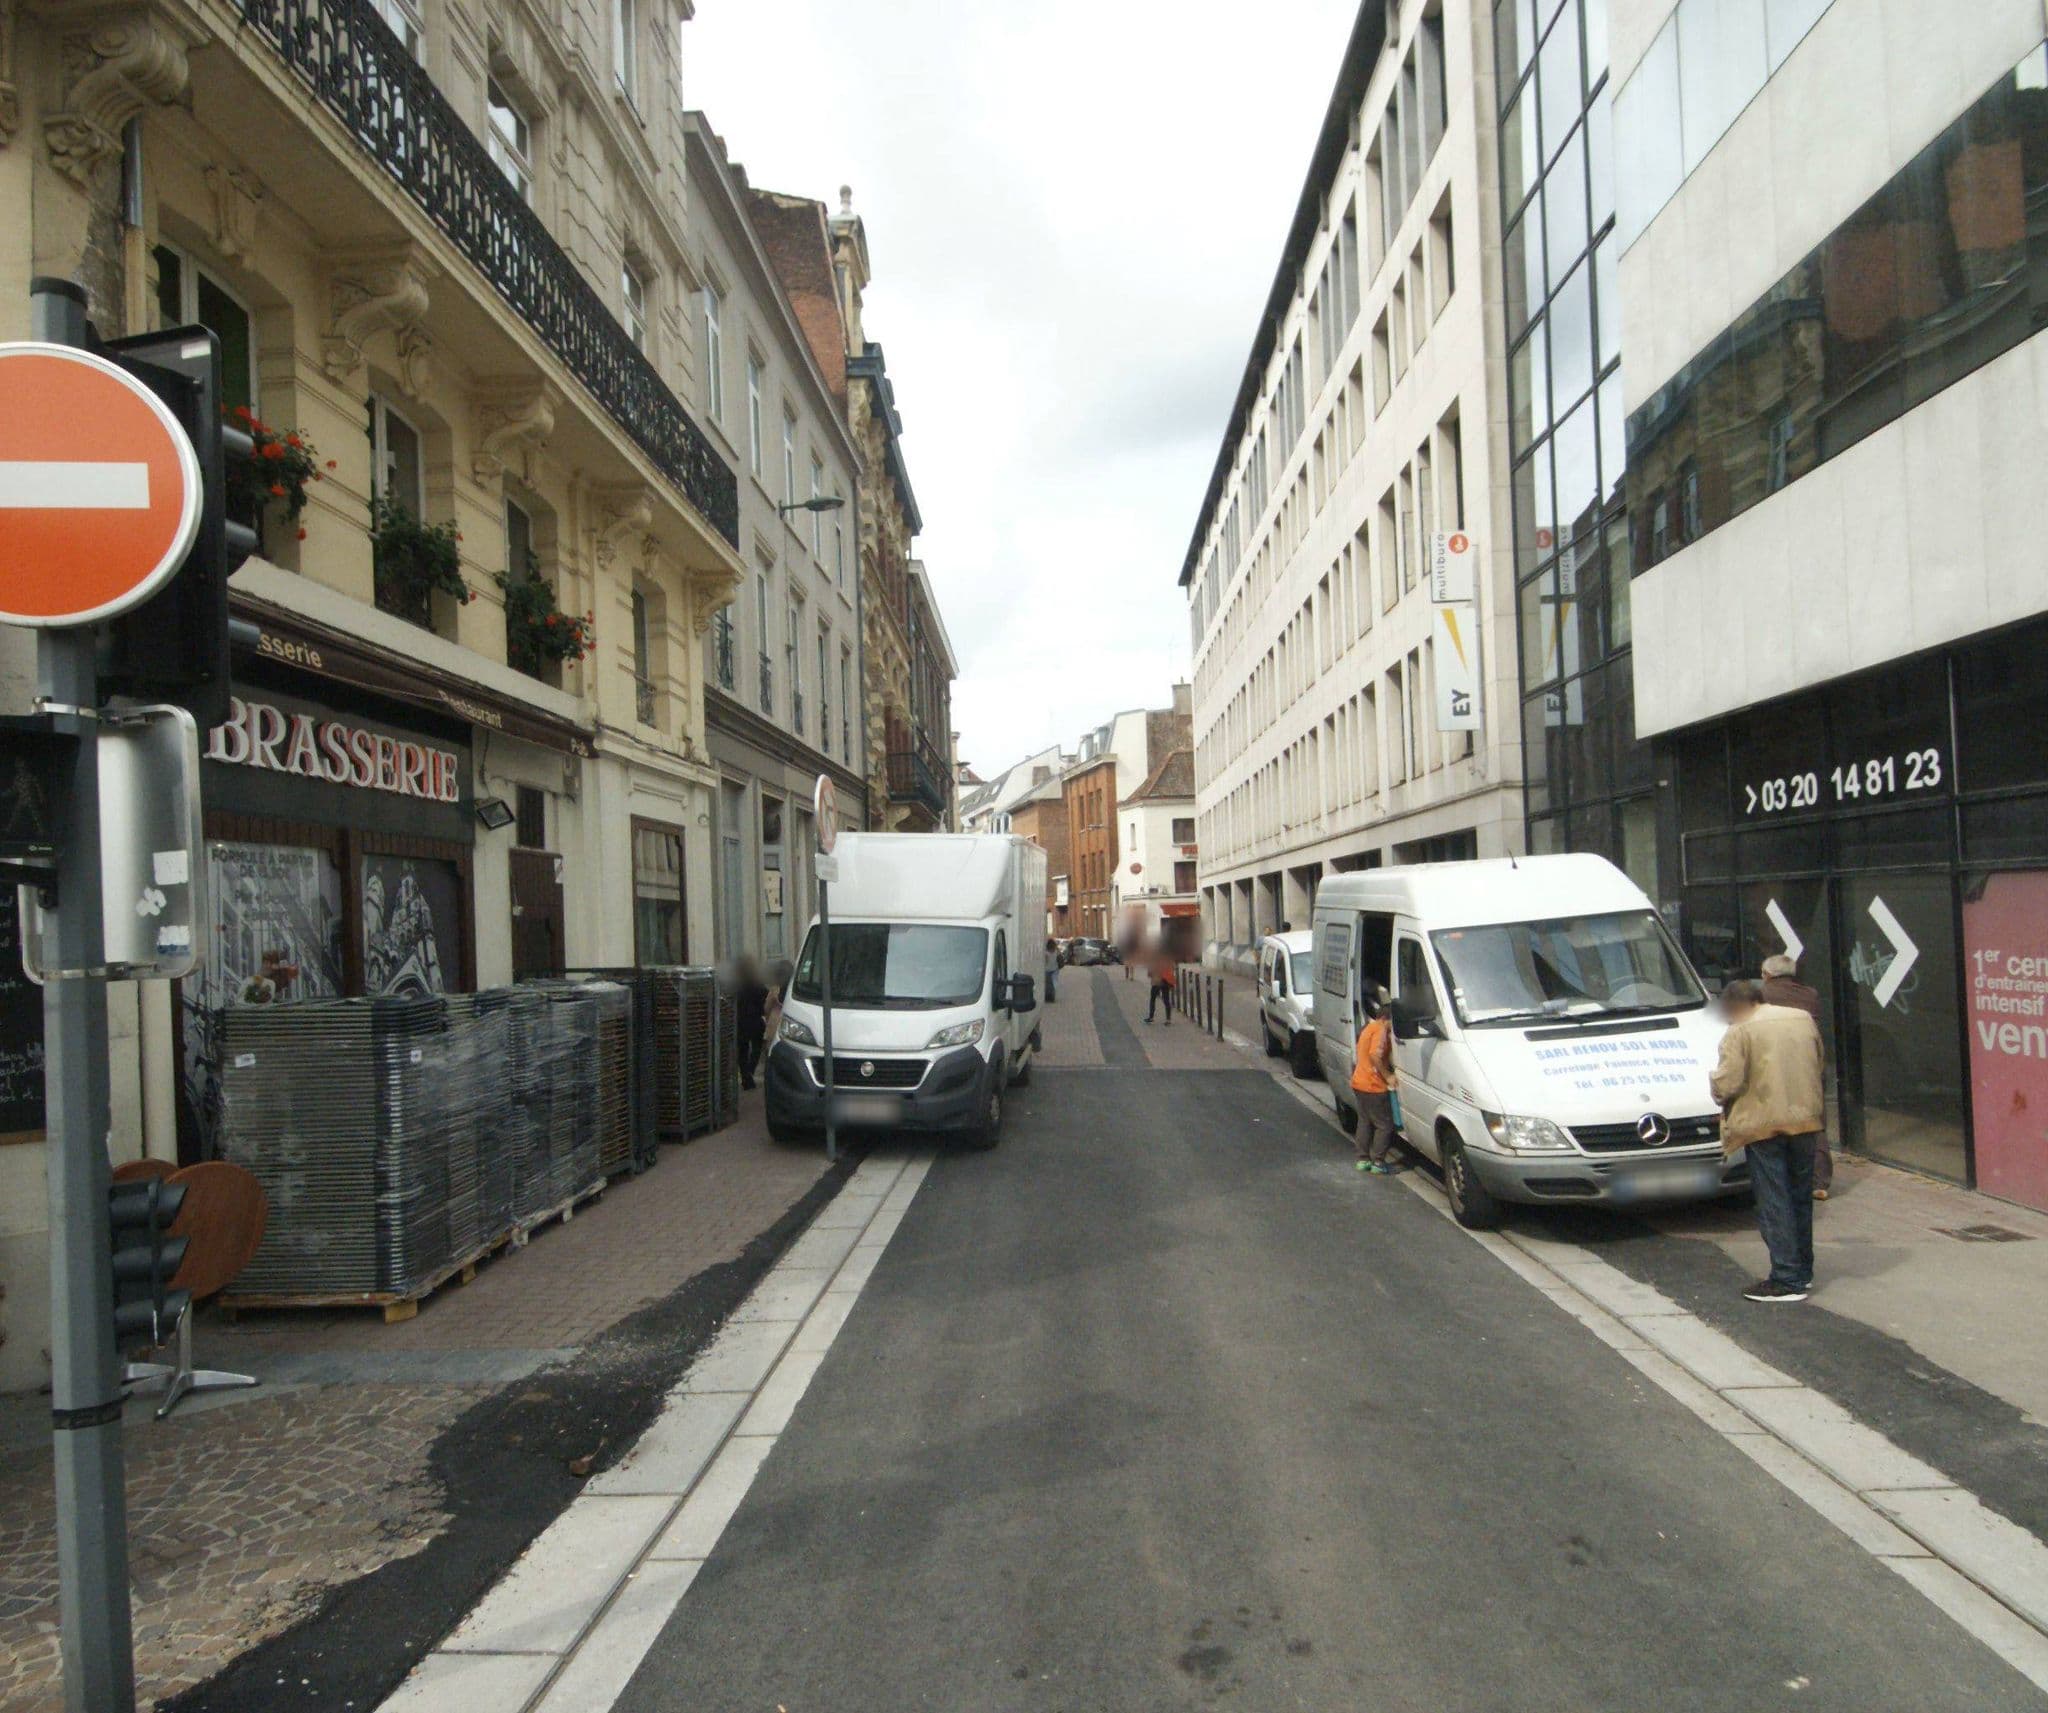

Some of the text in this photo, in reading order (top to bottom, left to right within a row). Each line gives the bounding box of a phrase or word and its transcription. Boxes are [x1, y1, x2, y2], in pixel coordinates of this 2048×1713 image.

[1437, 533, 1447, 600] multiburo
[257, 633, 322, 668] sserie
[1452, 688, 1471, 717] EY
[203, 696, 460, 802] BRASSERIE
[1761, 747, 1942, 812] 03 20 14 81 23
[1975, 991, 2045, 1017] intensif
[1535, 1039, 1689, 1061] SARL RENOV SOL NORD
[1977, 1020, 2048, 1060] ven
